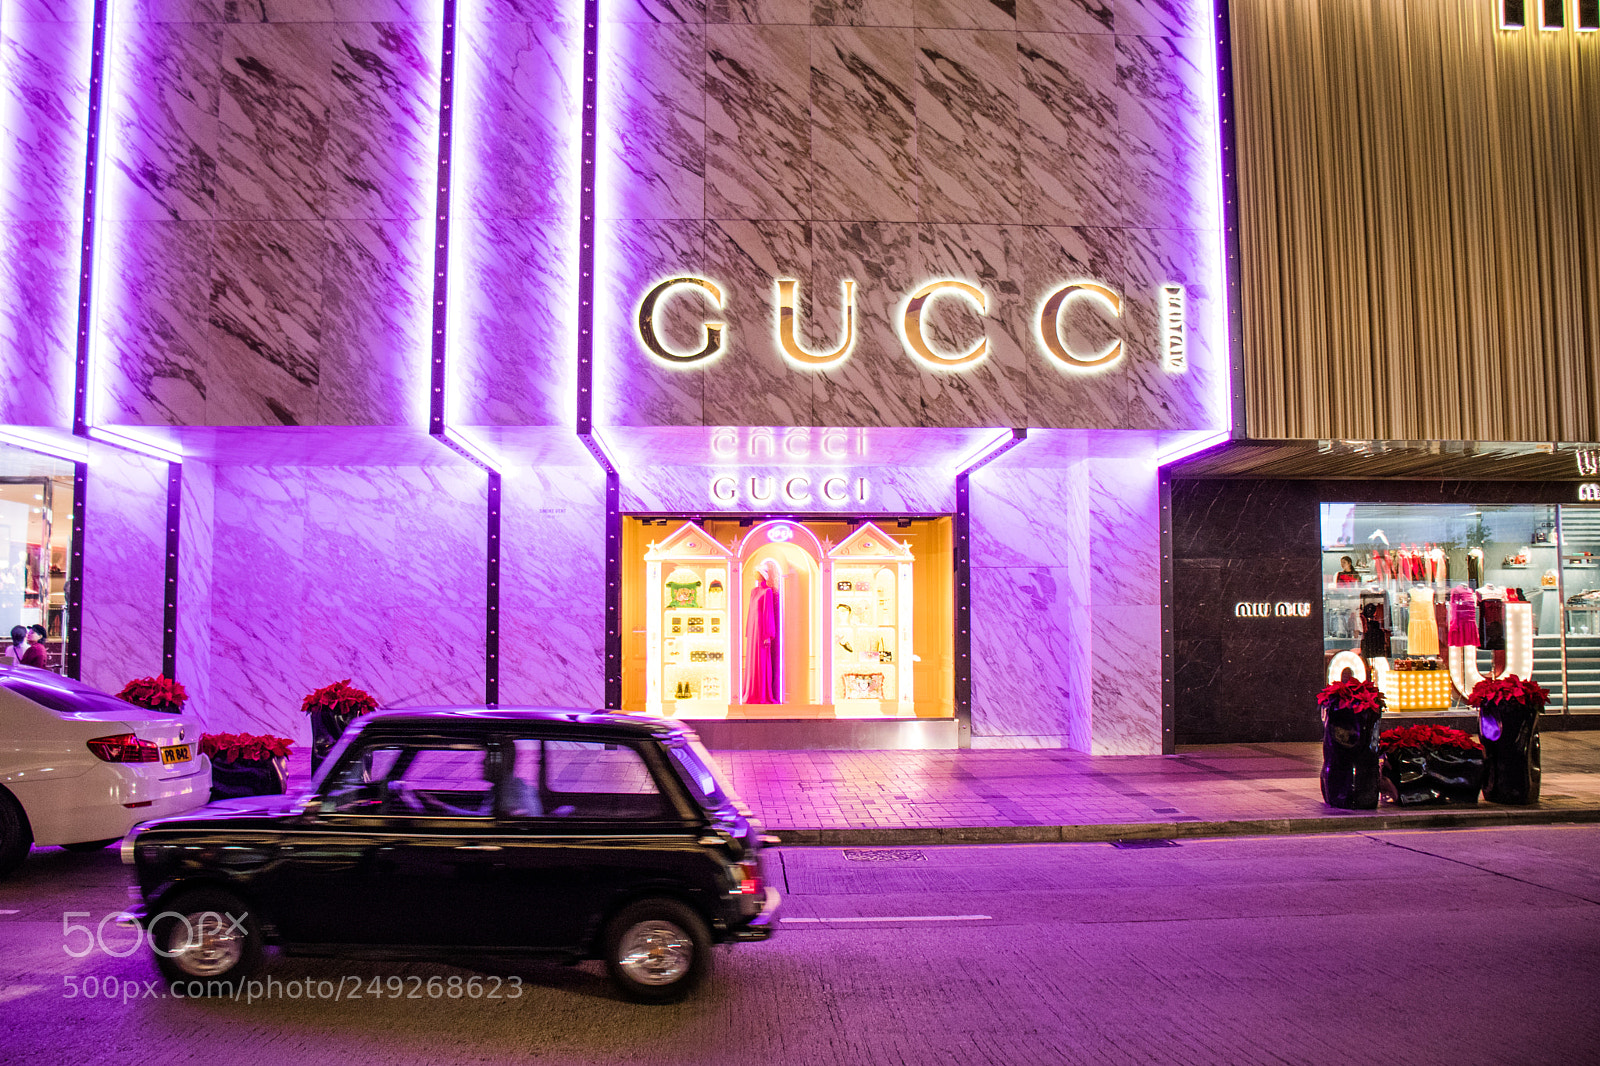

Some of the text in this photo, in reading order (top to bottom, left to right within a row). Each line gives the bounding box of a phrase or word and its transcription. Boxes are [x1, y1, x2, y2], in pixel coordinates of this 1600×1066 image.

[638, 276, 1187, 369] GUCCI
[713, 477, 864, 500] GUCCI
[164, 748, 189, 762] PR 842
